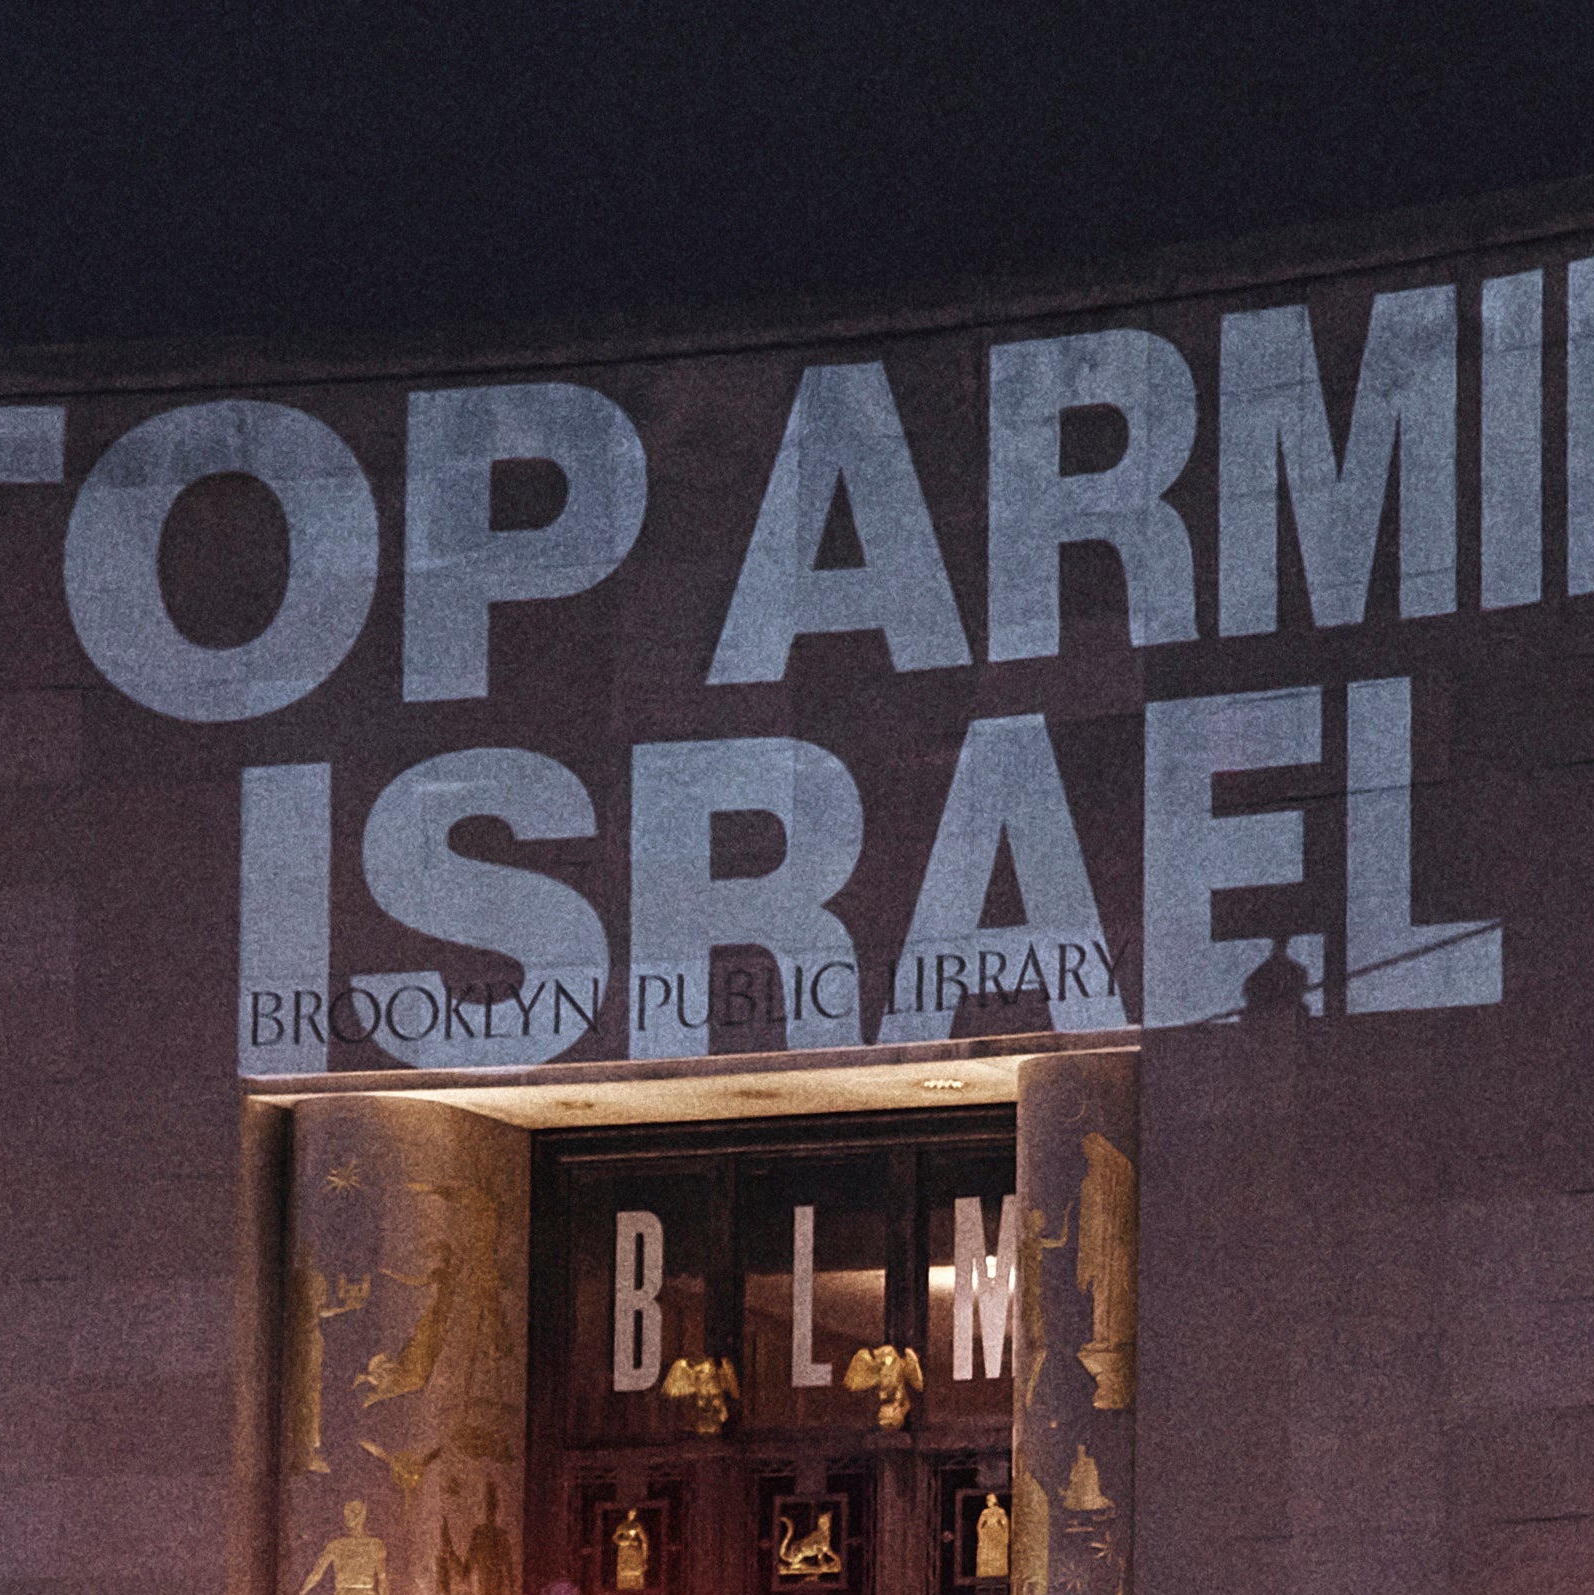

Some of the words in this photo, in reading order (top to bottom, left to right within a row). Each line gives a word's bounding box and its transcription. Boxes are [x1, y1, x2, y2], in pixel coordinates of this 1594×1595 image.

[237, 676, 1504, 1075] ISRAEL
[250, 974, 601, 1048] BROOKLYN
[636, 961, 859, 1032] PUBLIC
[886, 940, 1132, 1019] LIBRARY
[613, 1210, 663, 1392] B
[791, 1205, 833, 1388] L
[952, 1194, 1018, 1381] M
